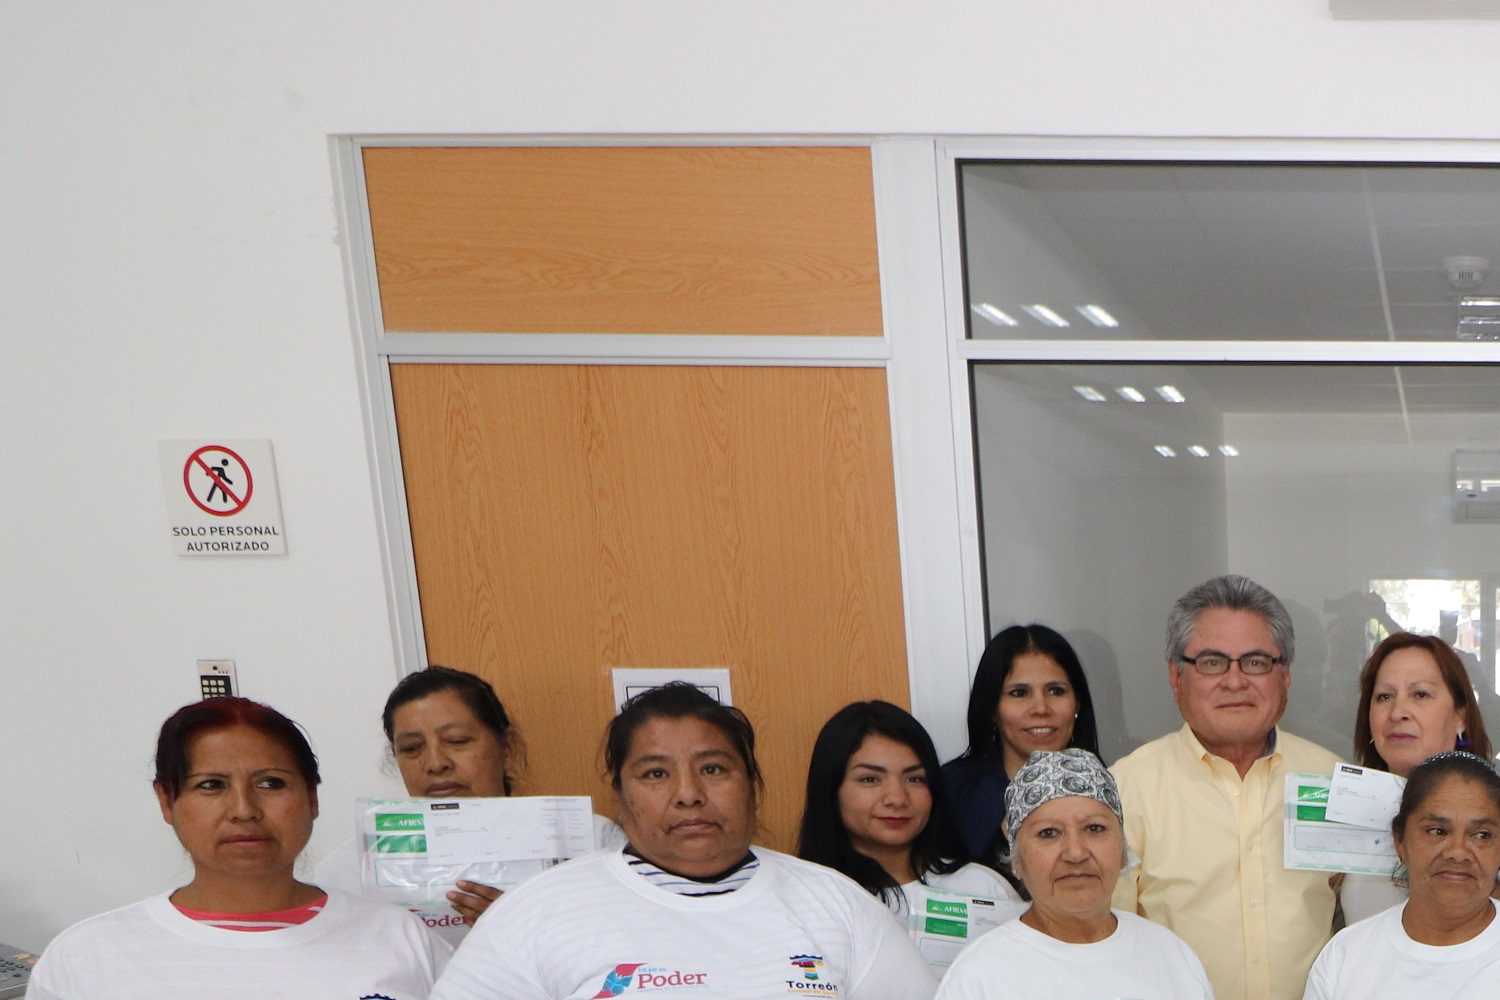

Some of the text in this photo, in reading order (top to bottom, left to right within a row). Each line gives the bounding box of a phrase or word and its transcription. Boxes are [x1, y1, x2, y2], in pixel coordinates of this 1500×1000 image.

[173, 526, 279, 536] SOLO PERSONAL
[187, 542, 269, 552] AUTORIZADO
[637, 971, 707, 989] Poder
[785, 980, 838, 991] Torreón
